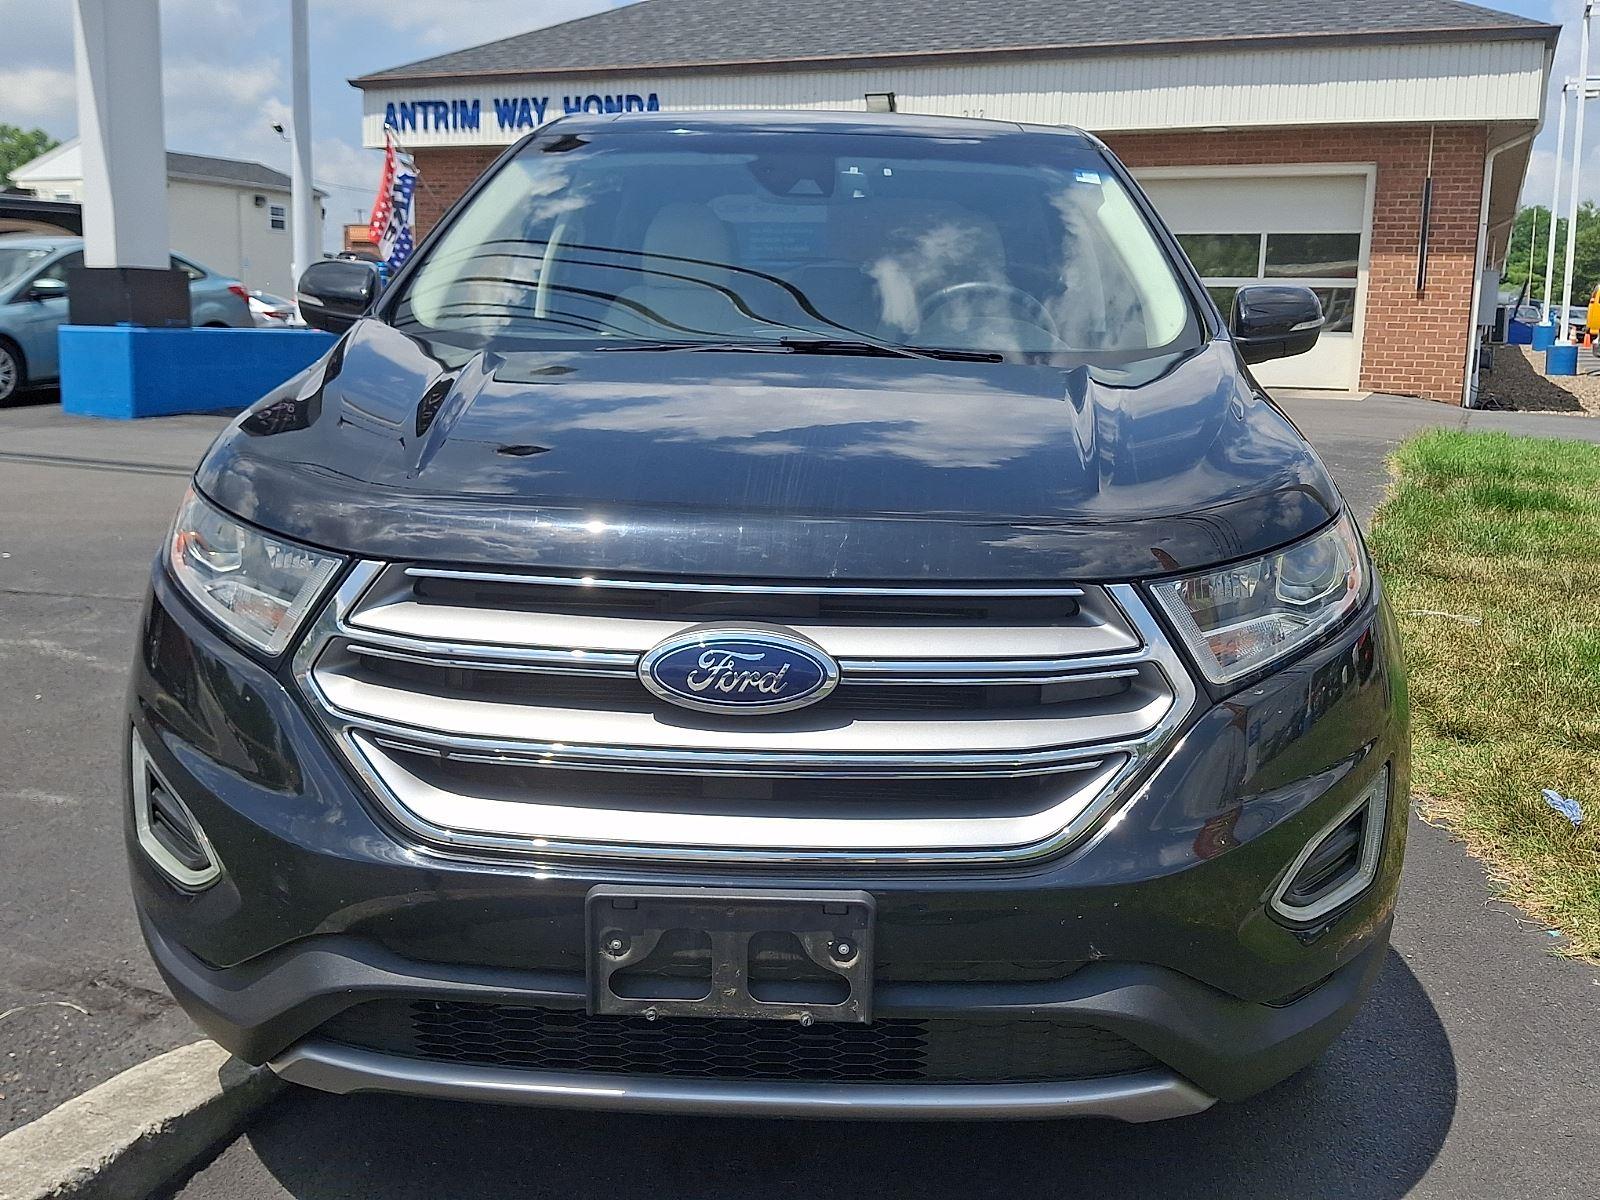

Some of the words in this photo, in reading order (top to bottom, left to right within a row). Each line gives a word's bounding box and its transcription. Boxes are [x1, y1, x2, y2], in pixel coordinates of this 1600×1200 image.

[385, 99, 480, 131] ANTRIM
[494, 97, 549, 129] WAY
[687, 649, 791, 694] Ford
